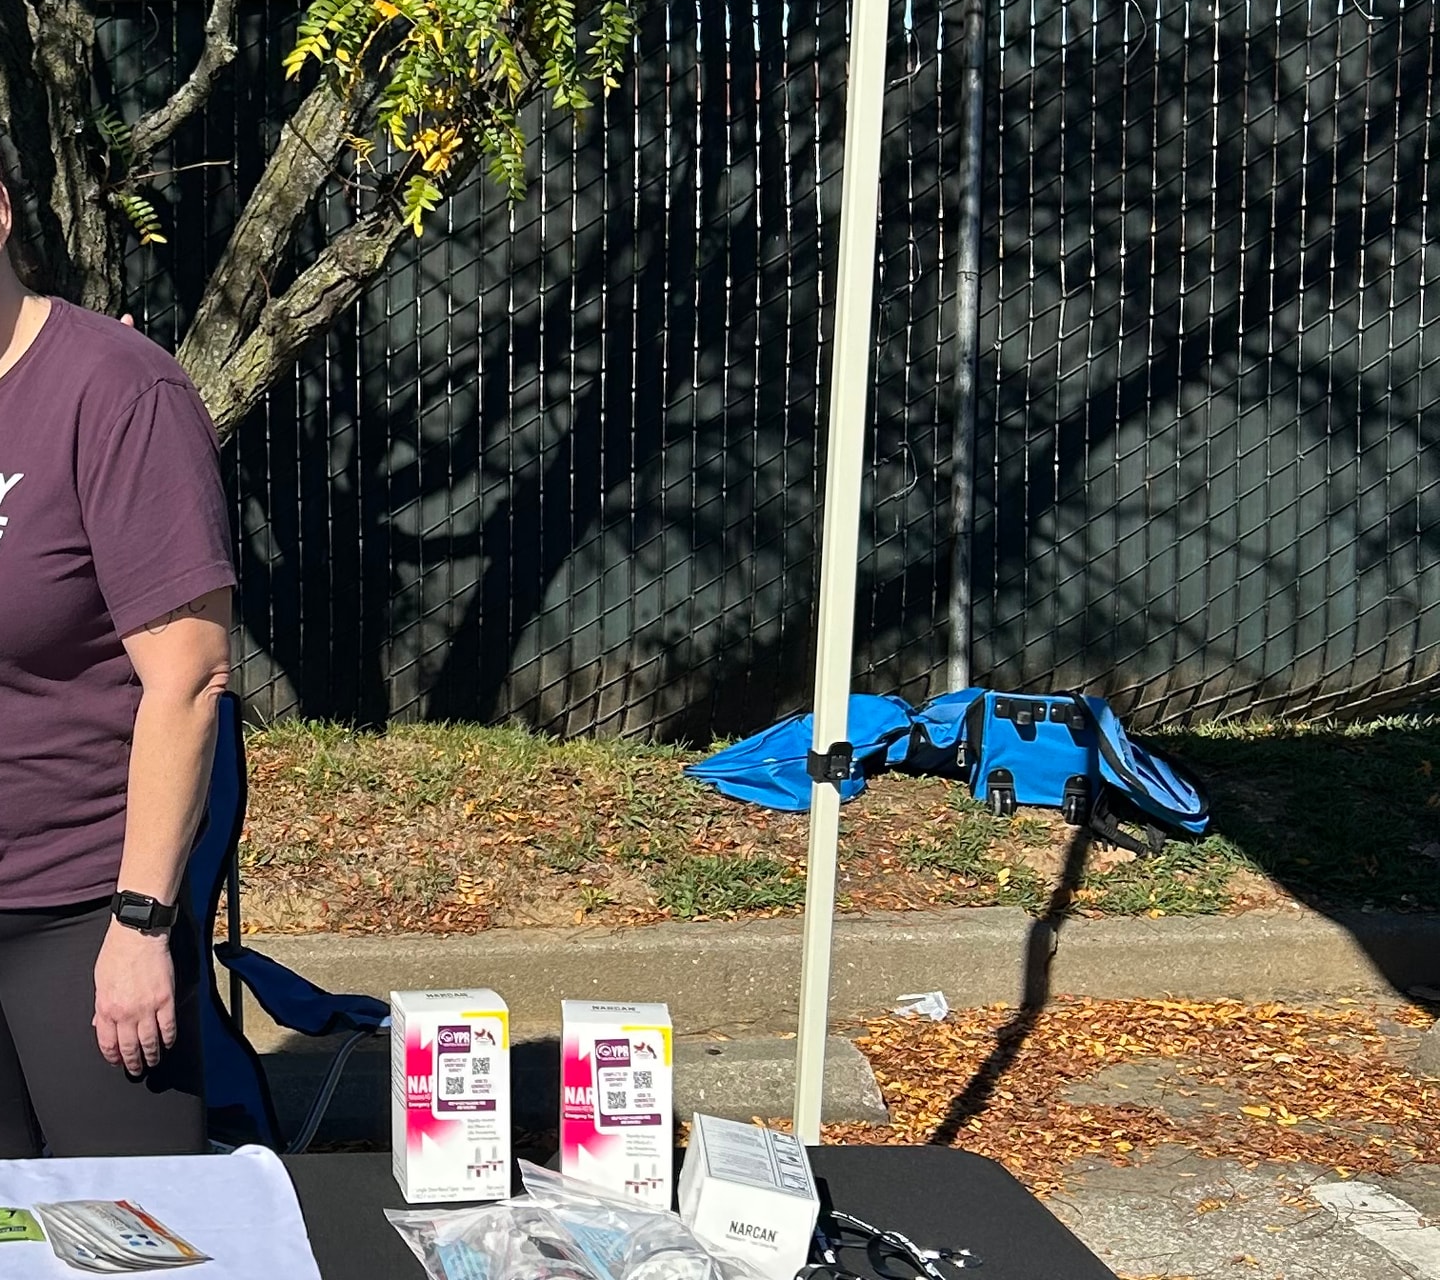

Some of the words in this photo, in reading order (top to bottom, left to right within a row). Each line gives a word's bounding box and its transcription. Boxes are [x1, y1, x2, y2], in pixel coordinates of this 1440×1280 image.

[453, 1031, 470, 1044] YPR
[612, 1045, 629, 1057] YPR
[564, 1086, 593, 1105] NAR
[729, 1220, 778, 1243] NARCAN
